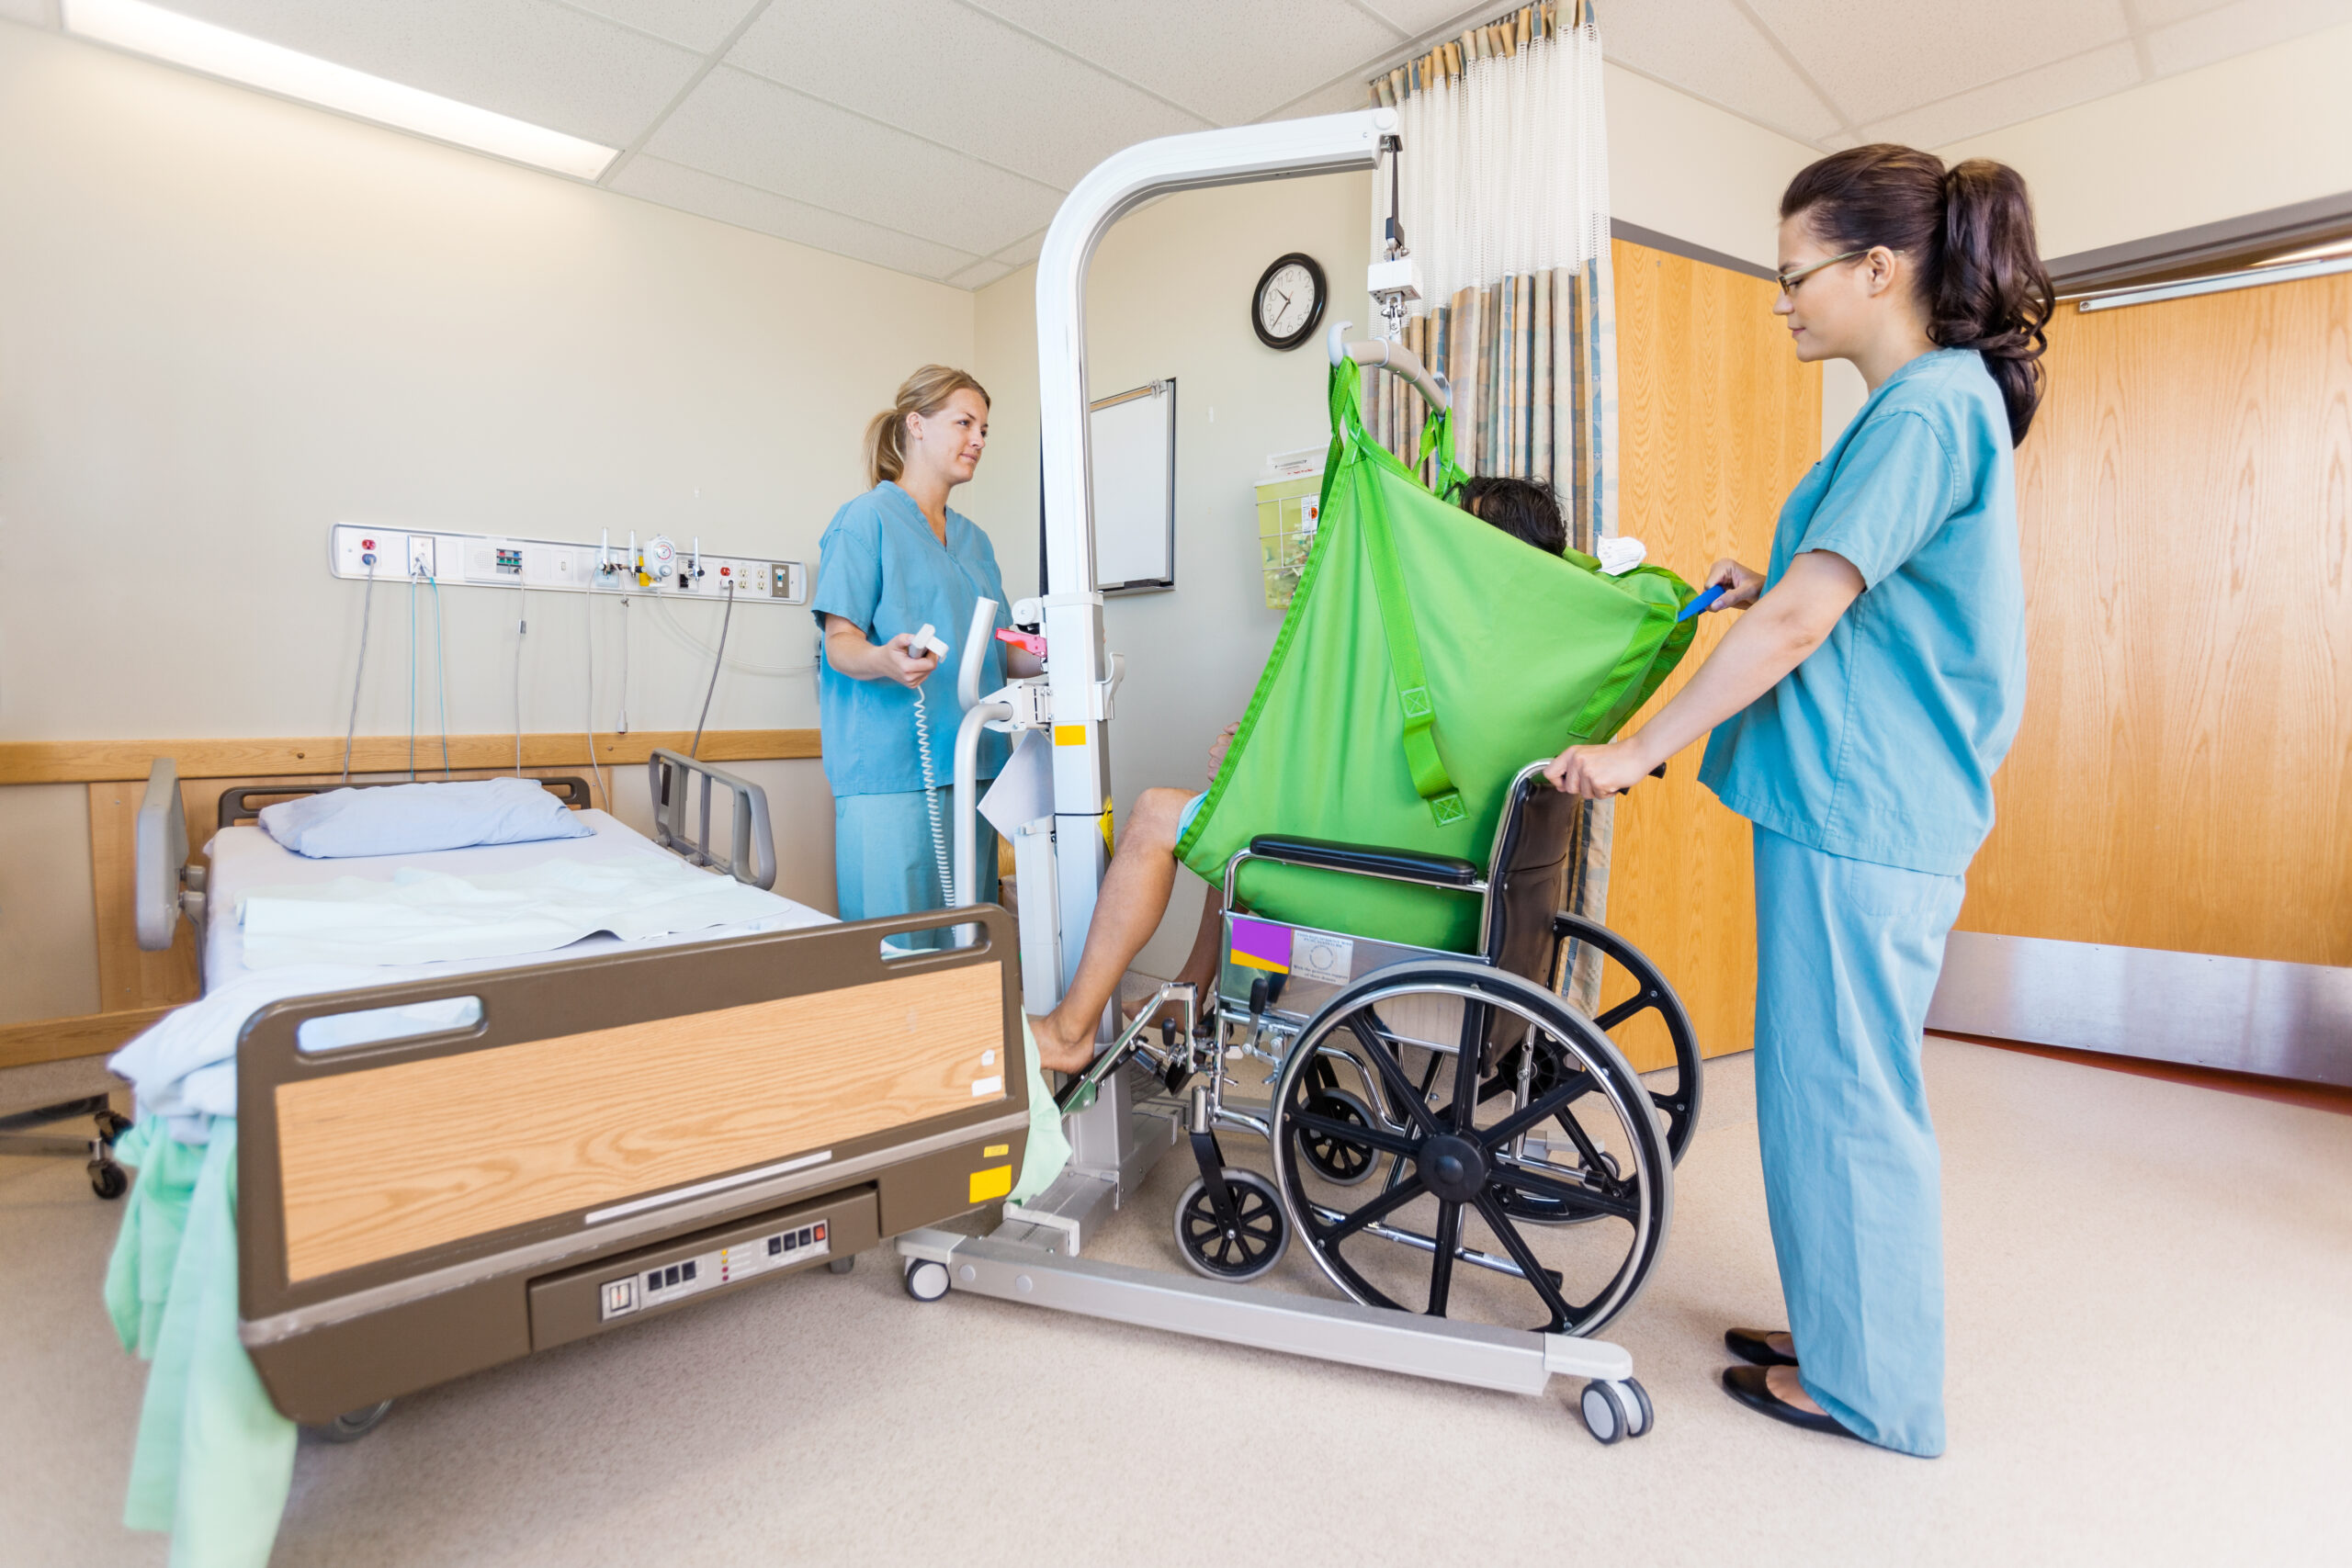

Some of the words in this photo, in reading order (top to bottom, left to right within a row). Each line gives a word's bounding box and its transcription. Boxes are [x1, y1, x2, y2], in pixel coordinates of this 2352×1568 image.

[1277, 276, 1283, 288] 11
[1286, 270, 1294, 282] 12
[1297, 271, 1302, 282] 1
[1305, 276, 1311, 288] 2
[1269, 288, 1277, 301] 10
[1308, 288, 1313, 301] 3
[1267, 303, 1272, 313] 9
[1304, 304, 1310, 314] 4
[1270, 315, 1275, 327] 8
[1297, 314, 1303, 326] 5
[1277, 322, 1283, 333] 7
[1287, 321, 1294, 333] 6
